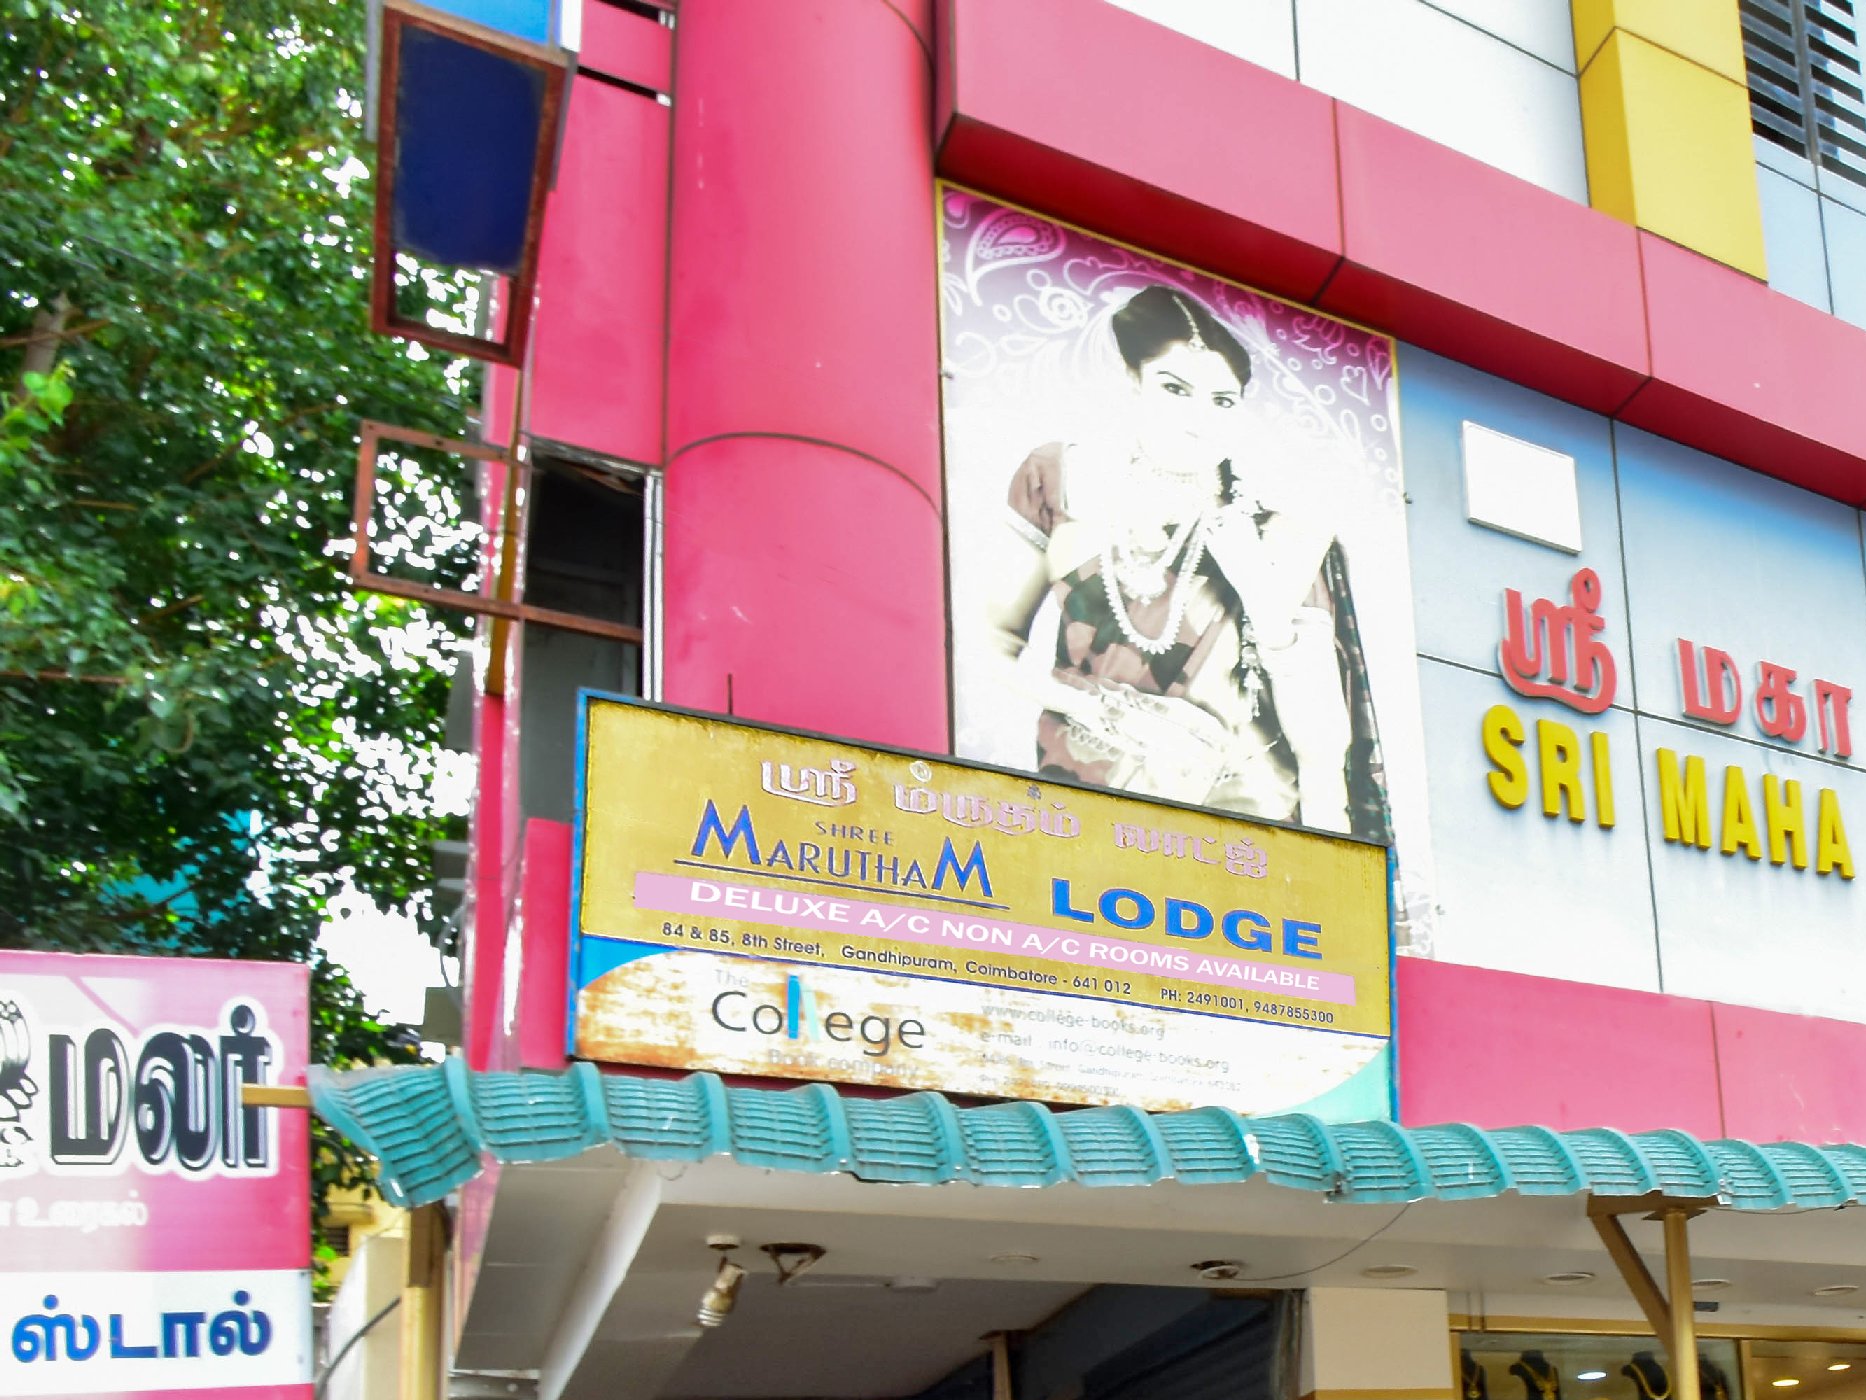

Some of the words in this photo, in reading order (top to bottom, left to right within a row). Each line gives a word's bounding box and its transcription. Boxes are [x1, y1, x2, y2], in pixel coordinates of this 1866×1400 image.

[1677, 637, 1853, 759] மகா
[815, 821, 895, 846] SHREE
[1482, 704, 1616, 829] SRI
[1656, 747, 1856, 881] MAHA
[691, 799, 993, 898] MARUTHAM
[1051, 877, 1323, 960] LODGE
[1113, 822, 1268, 879] லாட்ஜ்
[662, 922, 684, 938] 84
[690, 927, 703, 940] &
[709, 929, 735, 947] 85,
[741, 933, 769, 950] 8th
[774, 937, 825, 958] Street,
[842, 945, 958, 974] Gandhipuram,
[966, 961, 1058, 985] Coimbatore
[1073, 976, 1098, 991] 641
[1104, 979, 1131, 995] 012
[1161, 988, 1182, 1002] PH:
[1187, 992, 1249, 1014] 2491001,
[1254, 1001, 1334, 1023] 9487855300
[690, 880, 850, 922] DELUXE
[860, 908, 930, 934] A/C
[941, 919, 1013, 946] NON
[1021, 933, 1080, 955] A/C
[1089, 942, 1190, 972] ROOMS
[1196, 959, 1320, 991] AVAILABLE
[713, 968, 748, 986] The
[711, 974, 926, 1057] College
[48, 1004, 272, 1172] மலர்
[827, 1055, 919, 1079] company
[12, 1290, 273, 1364] ஸ்டால்
